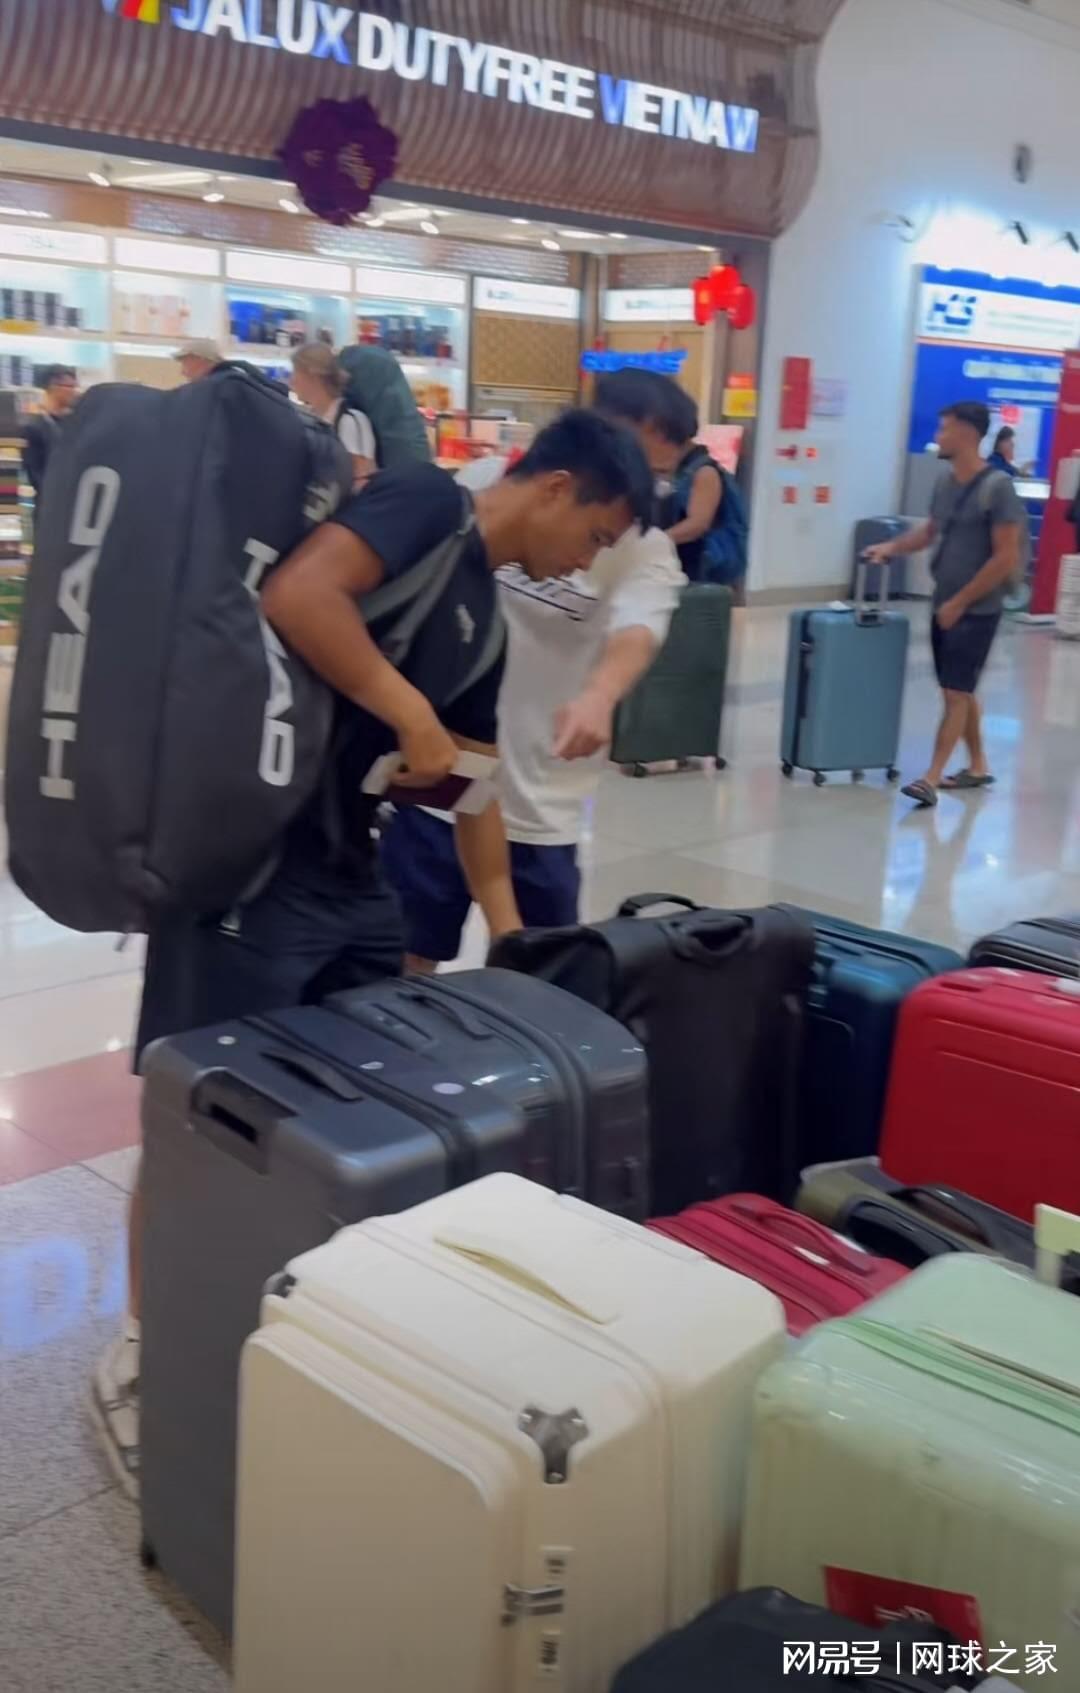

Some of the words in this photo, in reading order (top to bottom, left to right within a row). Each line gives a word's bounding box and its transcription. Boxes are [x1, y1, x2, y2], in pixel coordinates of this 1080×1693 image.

[171, 0, 352, 65] JALUX
[356, 12, 596, 119] DUTYFREE
[39, 465, 120, 801] HEAD
